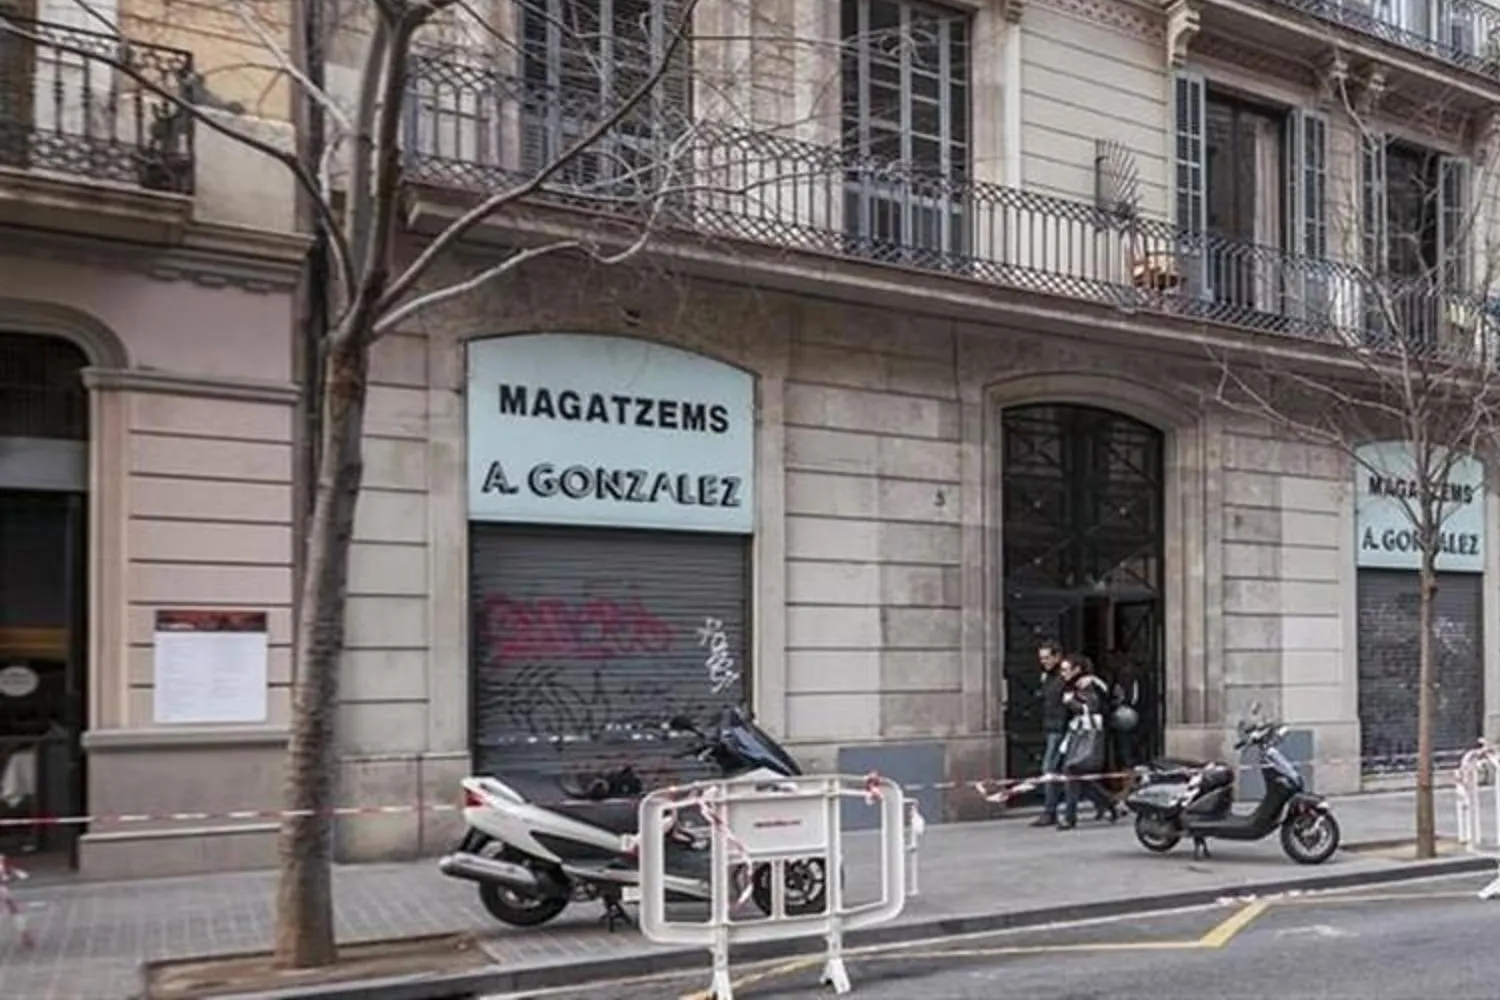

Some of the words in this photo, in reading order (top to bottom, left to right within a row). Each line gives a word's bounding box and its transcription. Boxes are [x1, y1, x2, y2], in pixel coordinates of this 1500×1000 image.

[498, 383, 730, 433] MAGATZEMS
[481, 460, 520, 495] A.
[527, 462, 743, 508] GONZALEZ
[1368, 475, 1473, 504] MAGAEMS
[1382, 528, 1480, 556] GOALEZ
